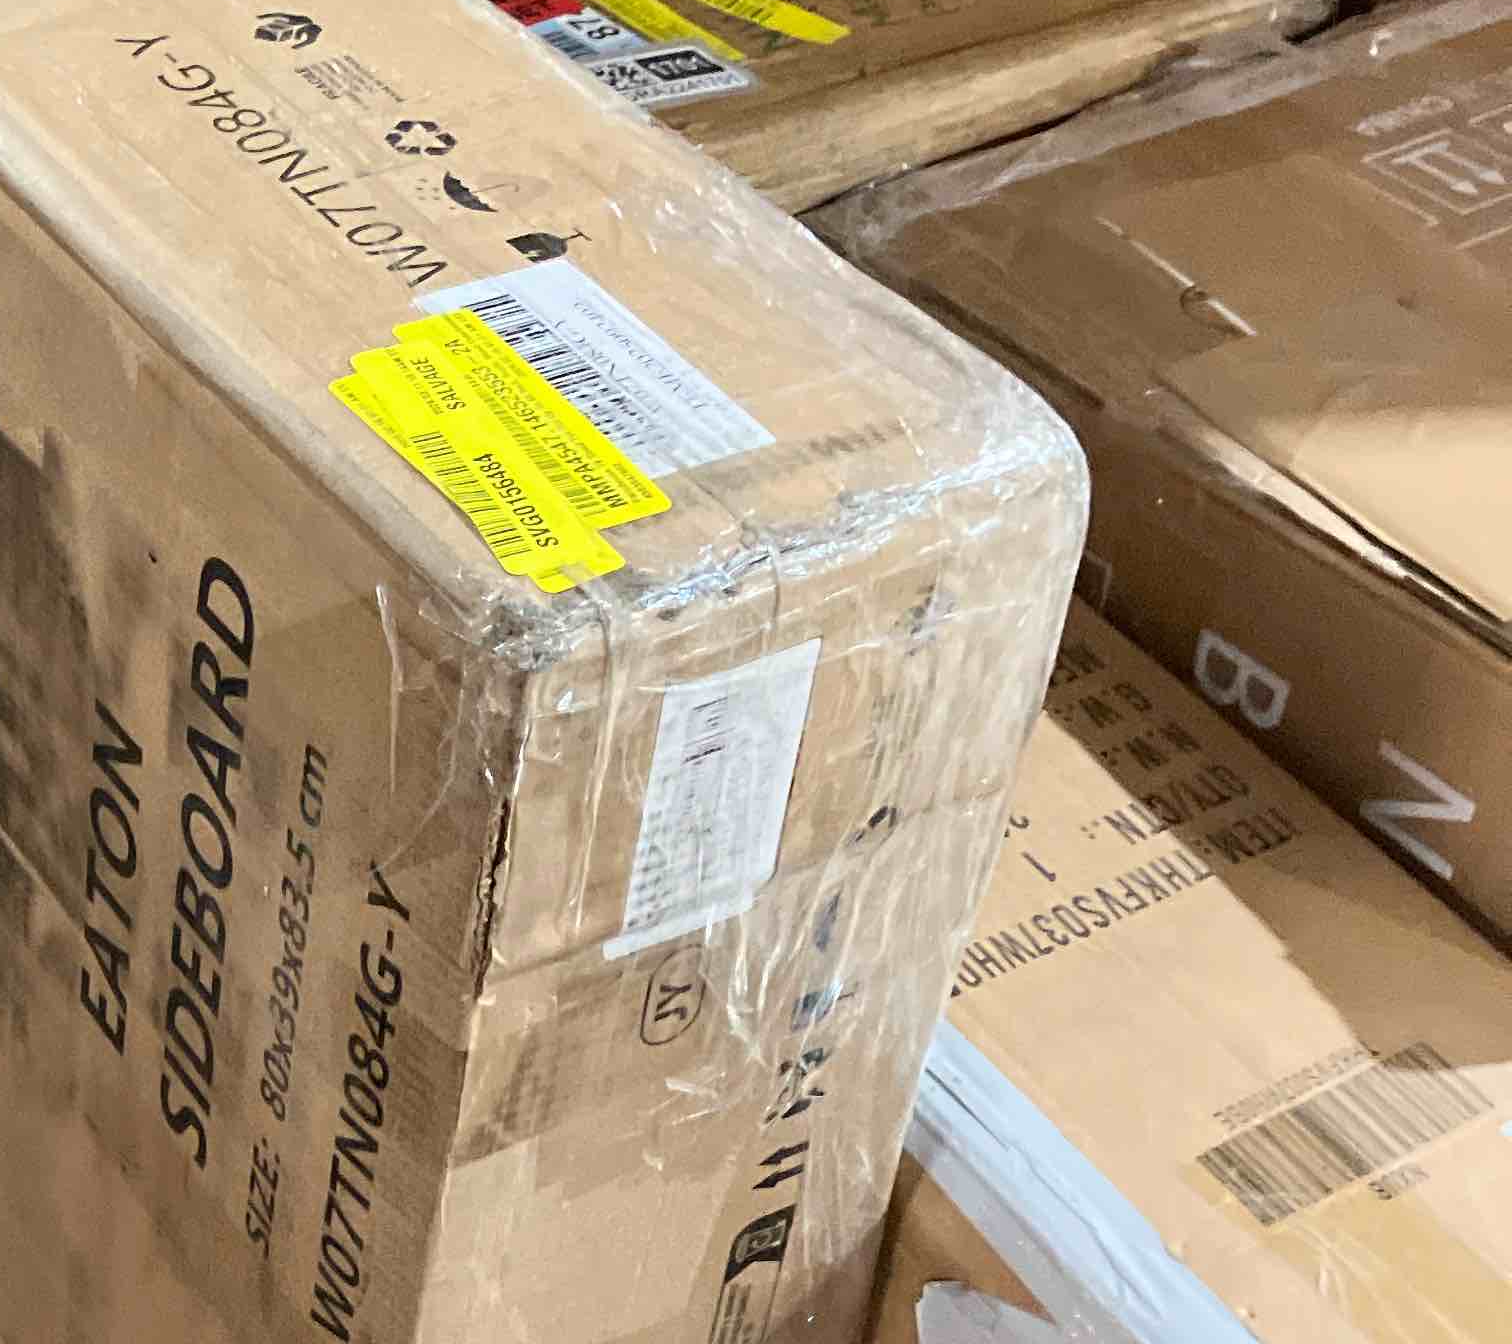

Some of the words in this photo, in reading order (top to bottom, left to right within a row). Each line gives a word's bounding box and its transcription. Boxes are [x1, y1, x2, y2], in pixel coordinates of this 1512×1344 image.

[568, 17, 620, 40] 87
[115, 33, 450, 289] W07TN084G-Y
[409, 358, 467, 412] SALVAGE
[473, 452, 560, 550] SVG0156484
[78, 698, 147, 1057] EATON
[160, 555, 258, 1171] SIDEBOARD
[244, 1137, 285, 1262] SIZE:
[295, 743, 329, 830] cm
[650, 976, 695, 1027] JY
